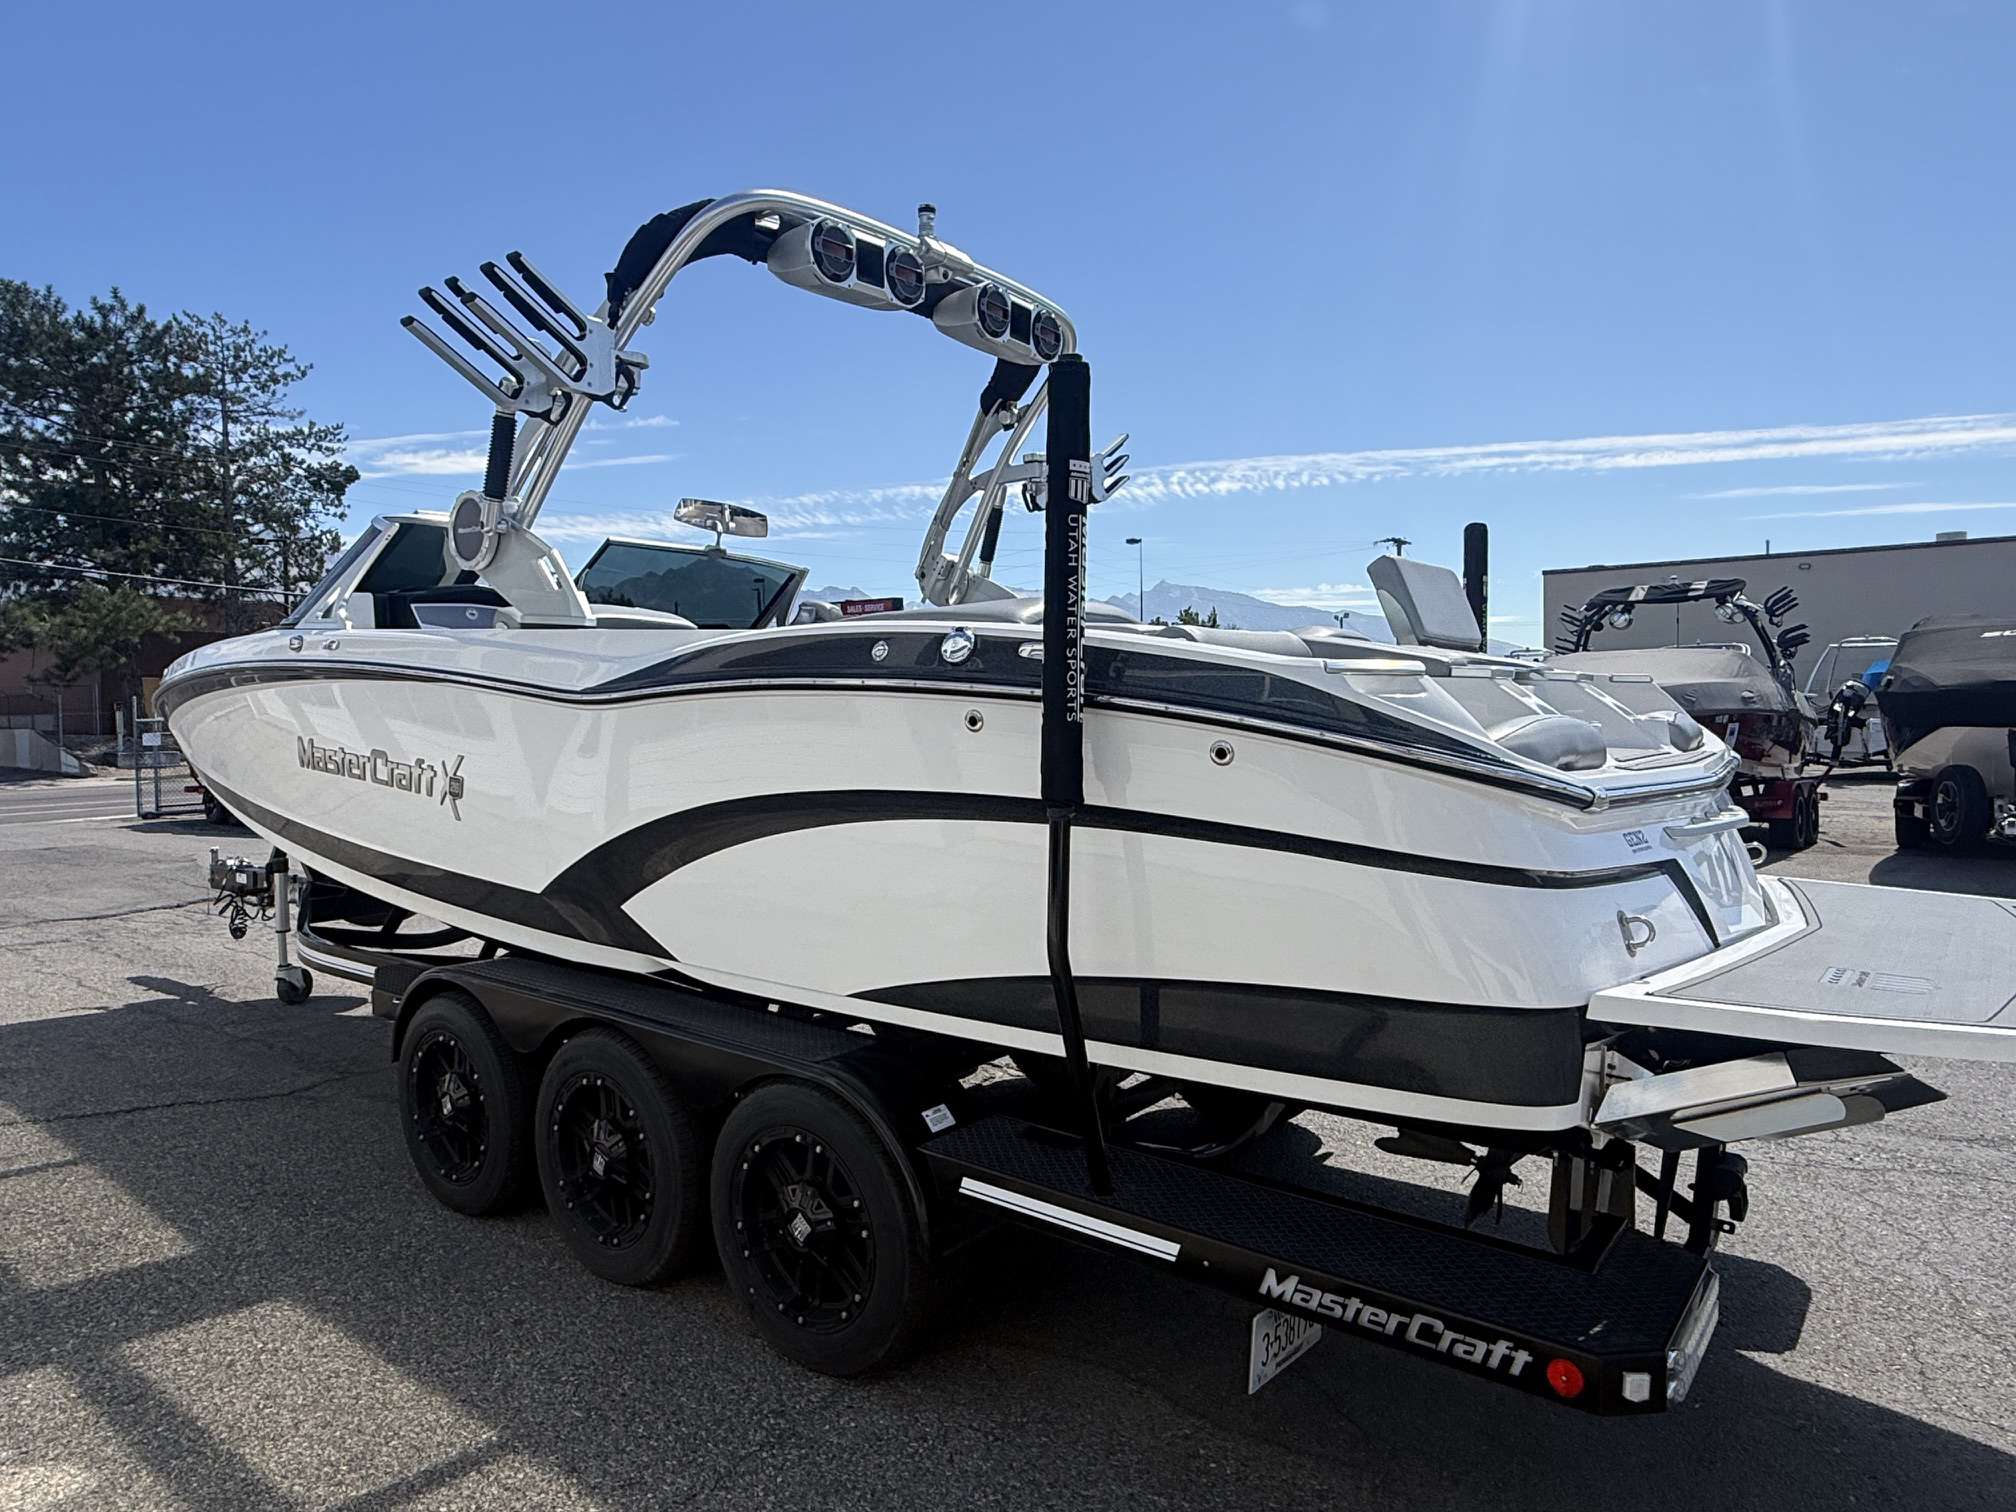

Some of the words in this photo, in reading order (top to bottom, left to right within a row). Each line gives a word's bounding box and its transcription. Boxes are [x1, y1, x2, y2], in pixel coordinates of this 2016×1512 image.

[1067, 514, 1078, 566] UTAH
[1066, 575, 1078, 639] WATER
[1066, 647, 1078, 722] SPORTS
[297, 735, 437, 798] MasterCraft
[1258, 1267, 1534, 1377] MasterCraft
